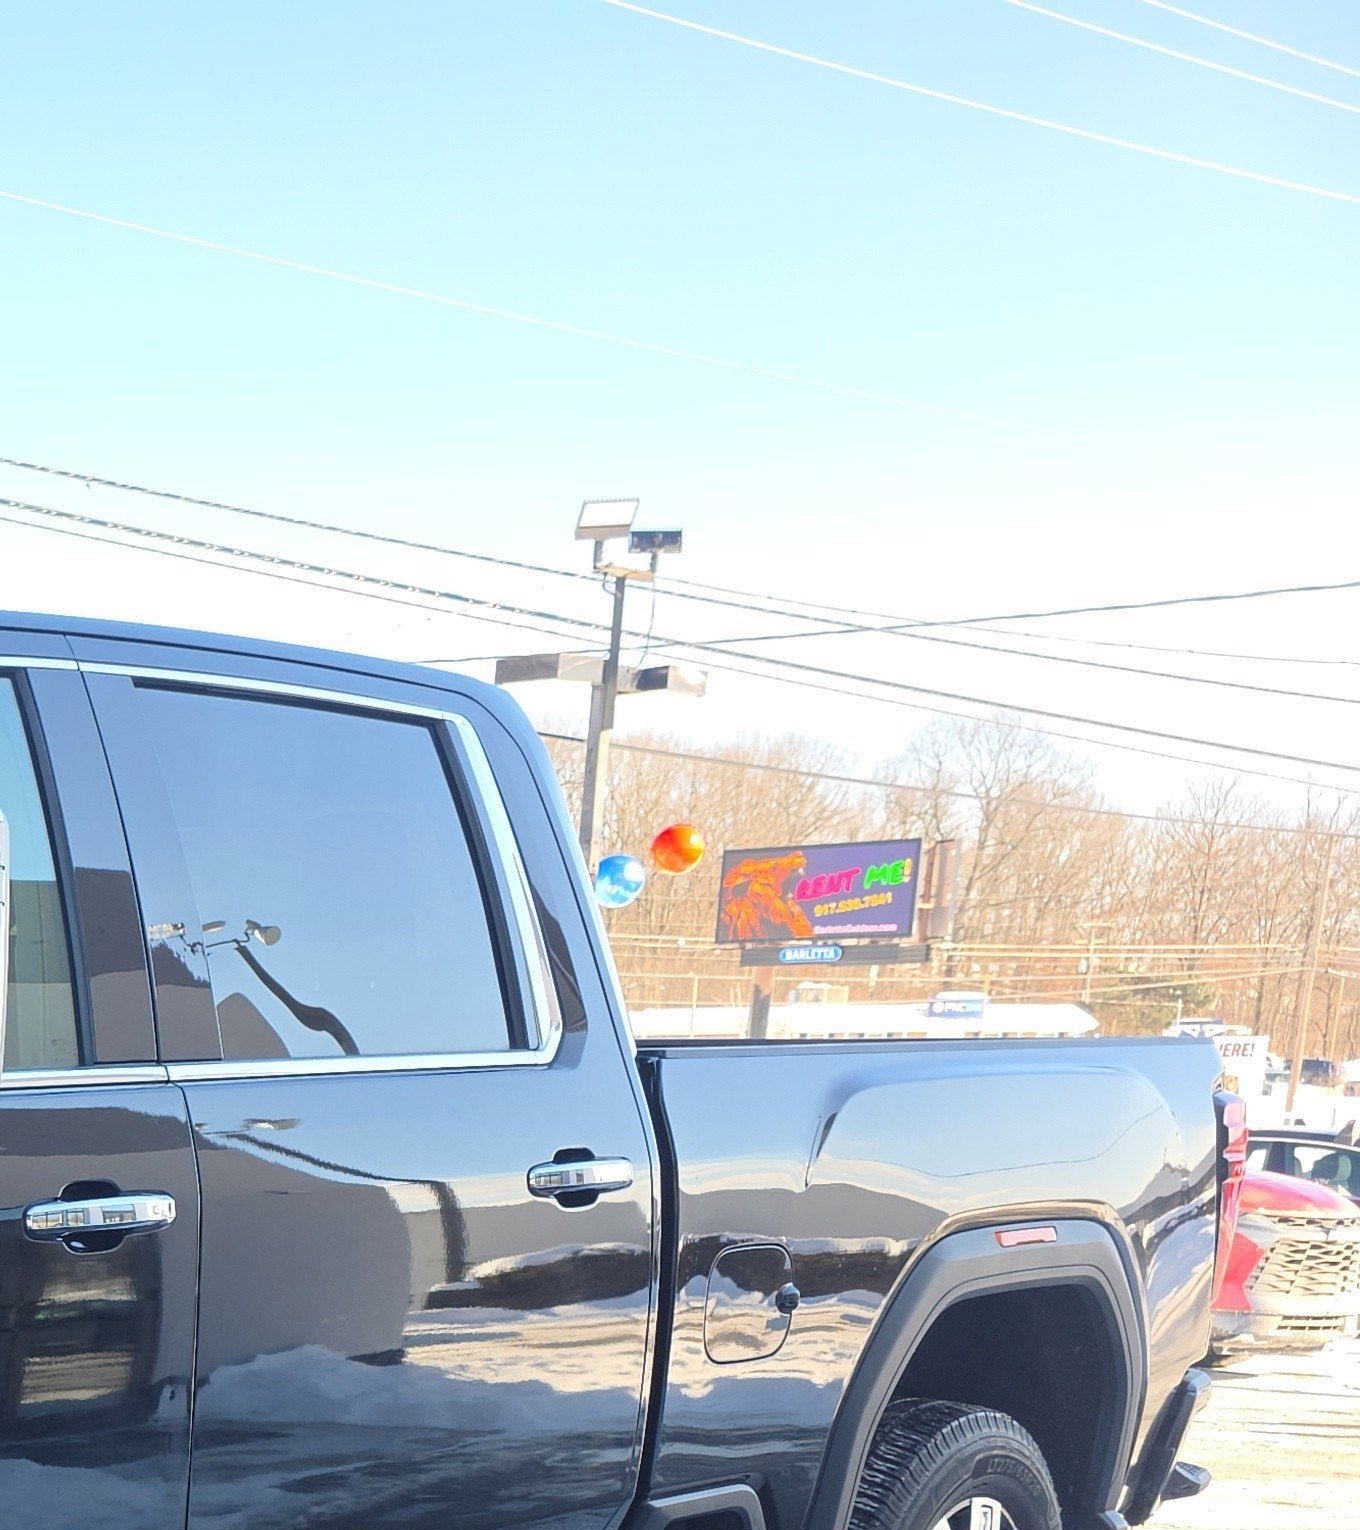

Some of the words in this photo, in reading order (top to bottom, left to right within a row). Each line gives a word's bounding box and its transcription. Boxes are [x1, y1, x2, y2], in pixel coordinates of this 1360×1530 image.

[795, 867, 862, 902] RENT
[862, 858, 912, 889] ME!
[1219, 1042, 1255, 1058] ERE!
